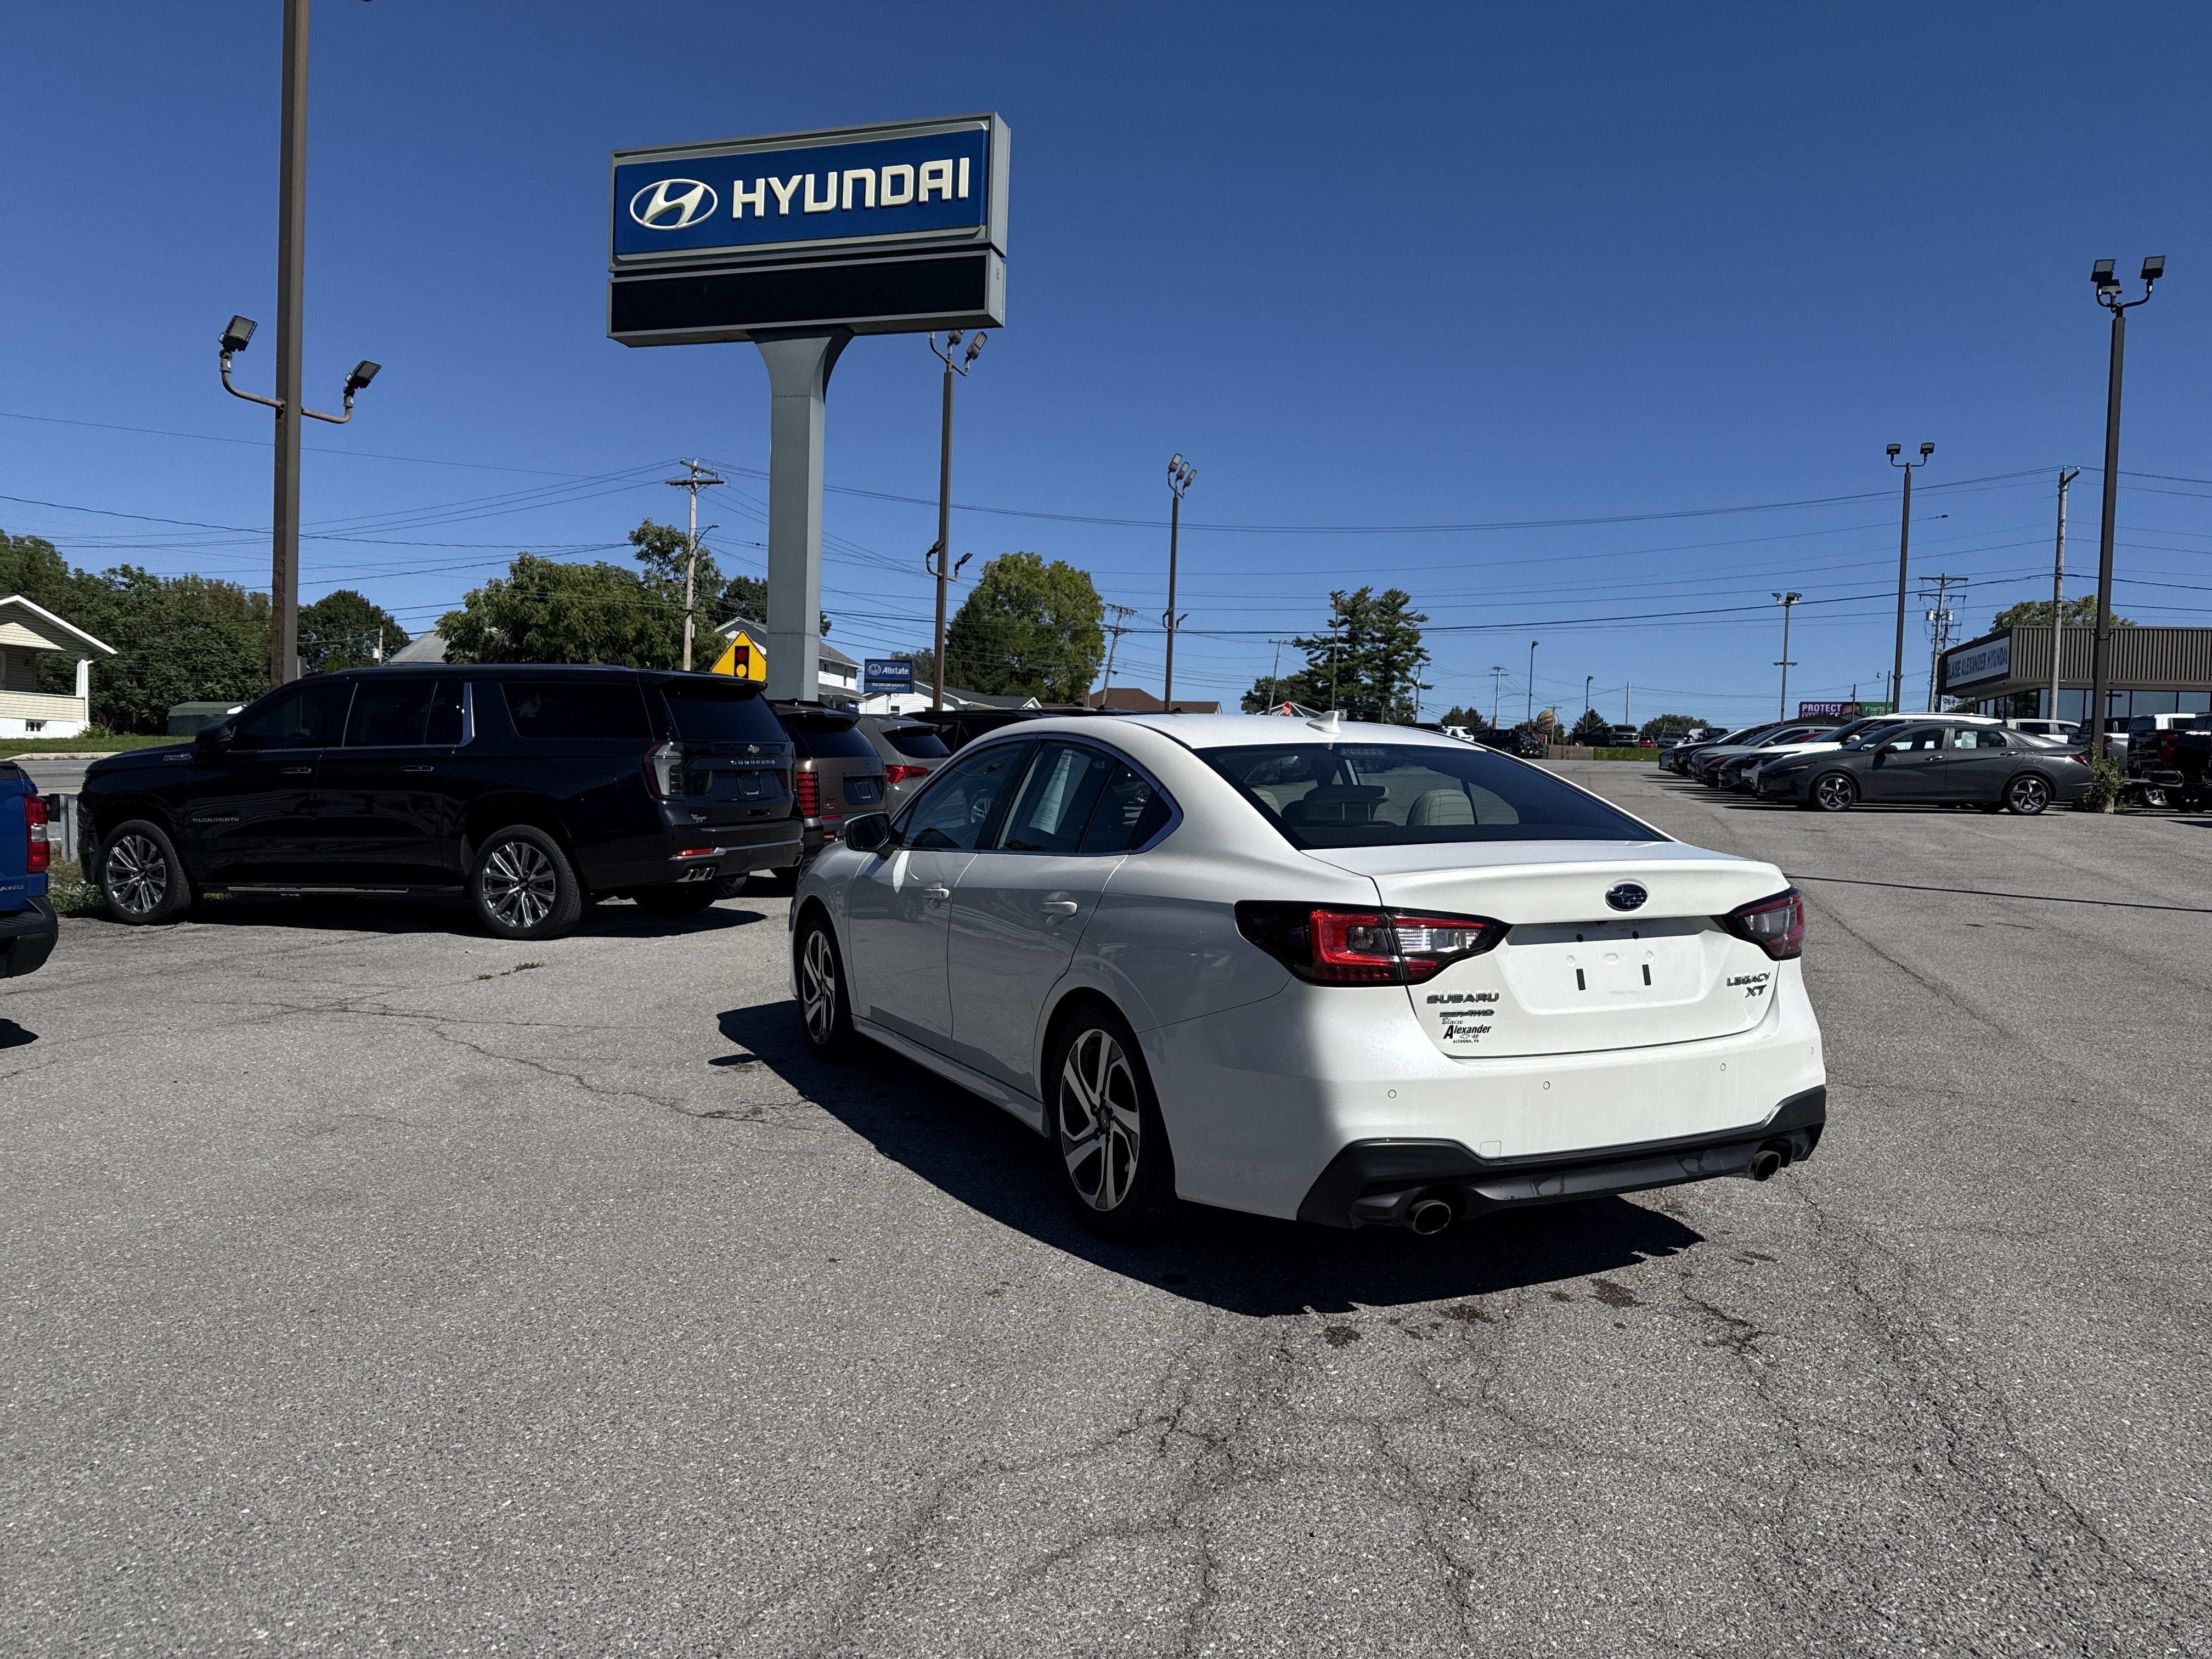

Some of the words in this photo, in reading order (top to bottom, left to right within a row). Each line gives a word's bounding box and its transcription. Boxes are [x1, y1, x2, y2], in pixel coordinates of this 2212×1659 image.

[732, 157, 969, 219] HYUNDAI
[1946, 660, 1961, 681] BLAISE
[1961, 651, 1987, 676] ALEXANDER
[1987, 645, 2008, 670] HYUNDAI
[882, 667, 909, 675] Allstate
[1802, 704, 1842, 712] PROTECT
[1727, 972, 1771, 986] LEGACY
[1745, 985, 1767, 998] XT
[1426, 993, 1499, 1004] SUBARU
[1443, 1024, 1492, 1039] Alexander
